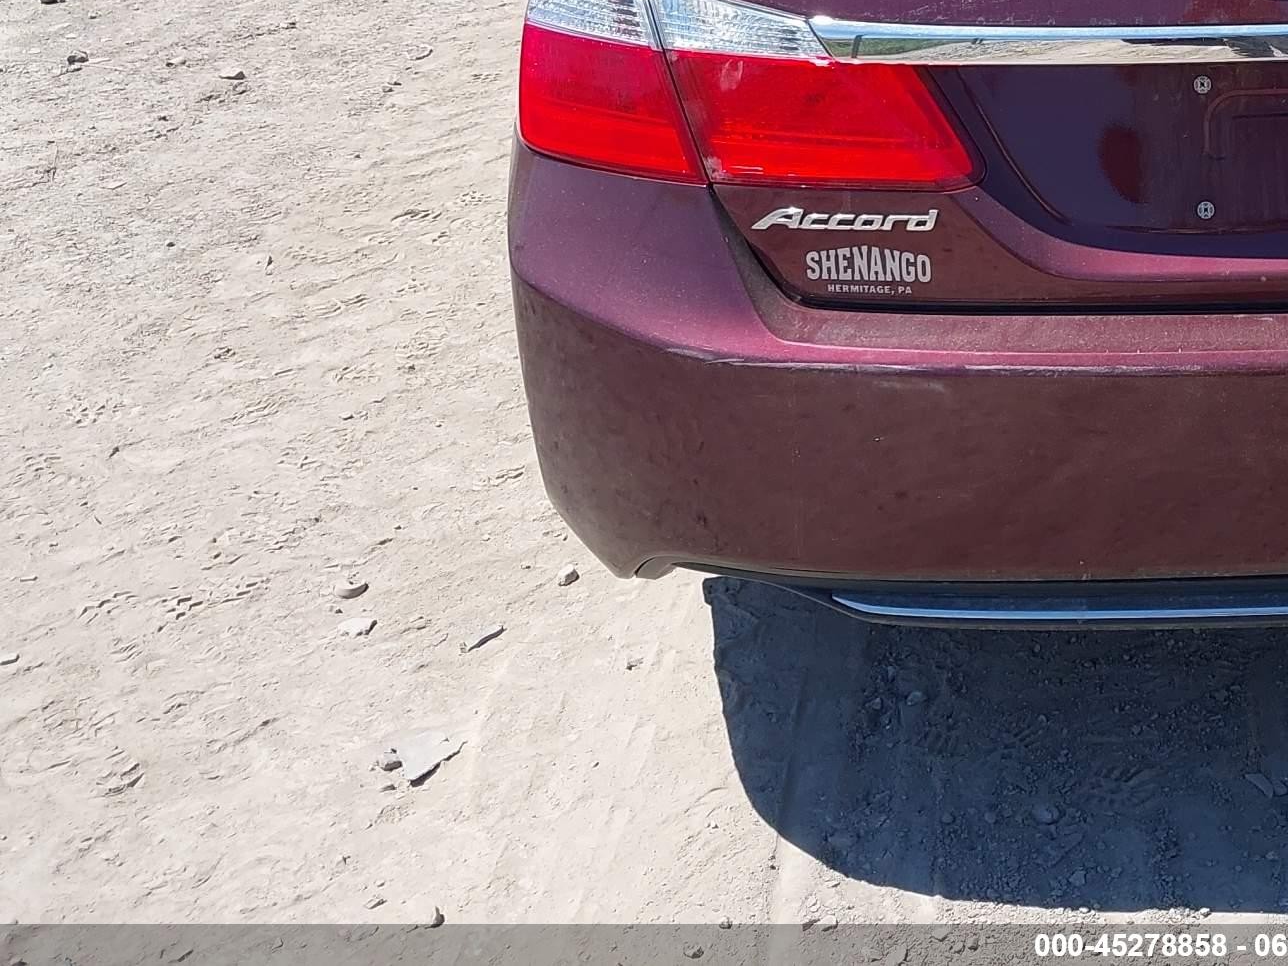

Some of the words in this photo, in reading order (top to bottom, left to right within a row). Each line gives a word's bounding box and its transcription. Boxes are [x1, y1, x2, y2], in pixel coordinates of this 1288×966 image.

[751, 206, 939, 231] Accord
[805, 245, 932, 282] SHENANGO
[827, 284, 895, 296] HERMITAGE,
[898, 285, 912, 295] PA
